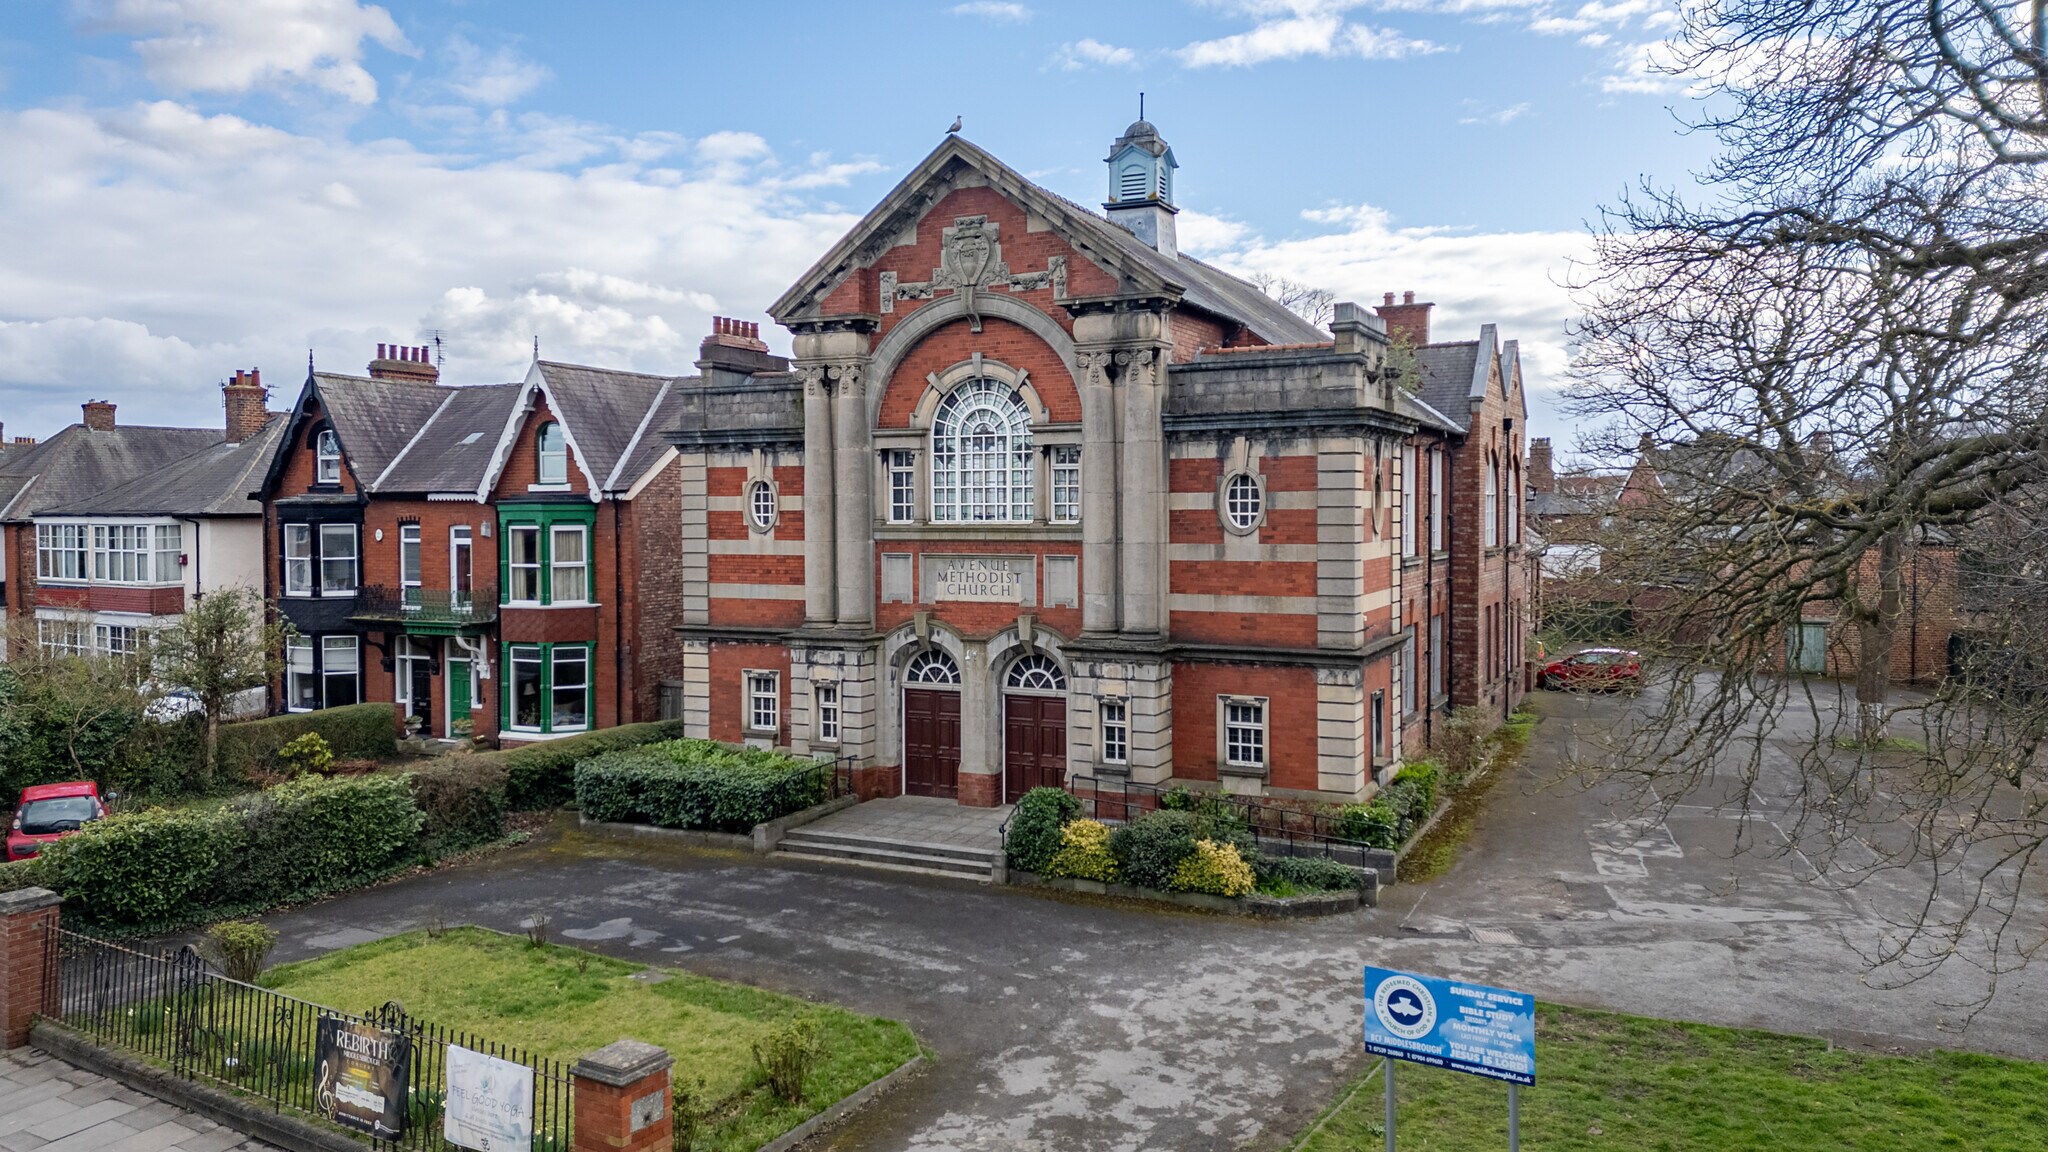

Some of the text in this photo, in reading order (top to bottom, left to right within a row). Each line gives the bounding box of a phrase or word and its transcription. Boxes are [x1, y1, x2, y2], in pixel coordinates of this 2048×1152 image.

[948, 560, 1008, 571] AVENUE
[938, 572, 1021, 584] METHODIST
[947, 584, 1010, 596] CHURCH
[1383, 980, 1410, 993] REDEEMED
[1412, 984, 1432, 1016] CHRISTIAN
[1450, 986, 1523, 1006] SUNDAY SERVICE
[1459, 1006, 1514, 1022] BIBLE STUDY
[1384, 1016, 1405, 1034] CHURCH
[1416, 1024, 1428, 1034] GOD
[1453, 1023, 1522, 1042] MONTHLY VIGIL
[336, 1030, 387, 1060] REBIRTH
[1384, 1036, 1442, 1055] MIDDLESBROUGH
[1449, 1041, 1528, 1063] YOU ARE WELCOME
[343, 1050, 380, 1066] MIDDLESBROUGH
[346, 1059, 374, 1070] CONCERT
[1450, 1049, 1528, 1072] JESUS IS LORD!
[452, 1085, 470, 1100] FEEL
[472, 1093, 496, 1108] GOOD
[500, 1102, 524, 1118] YOGA
